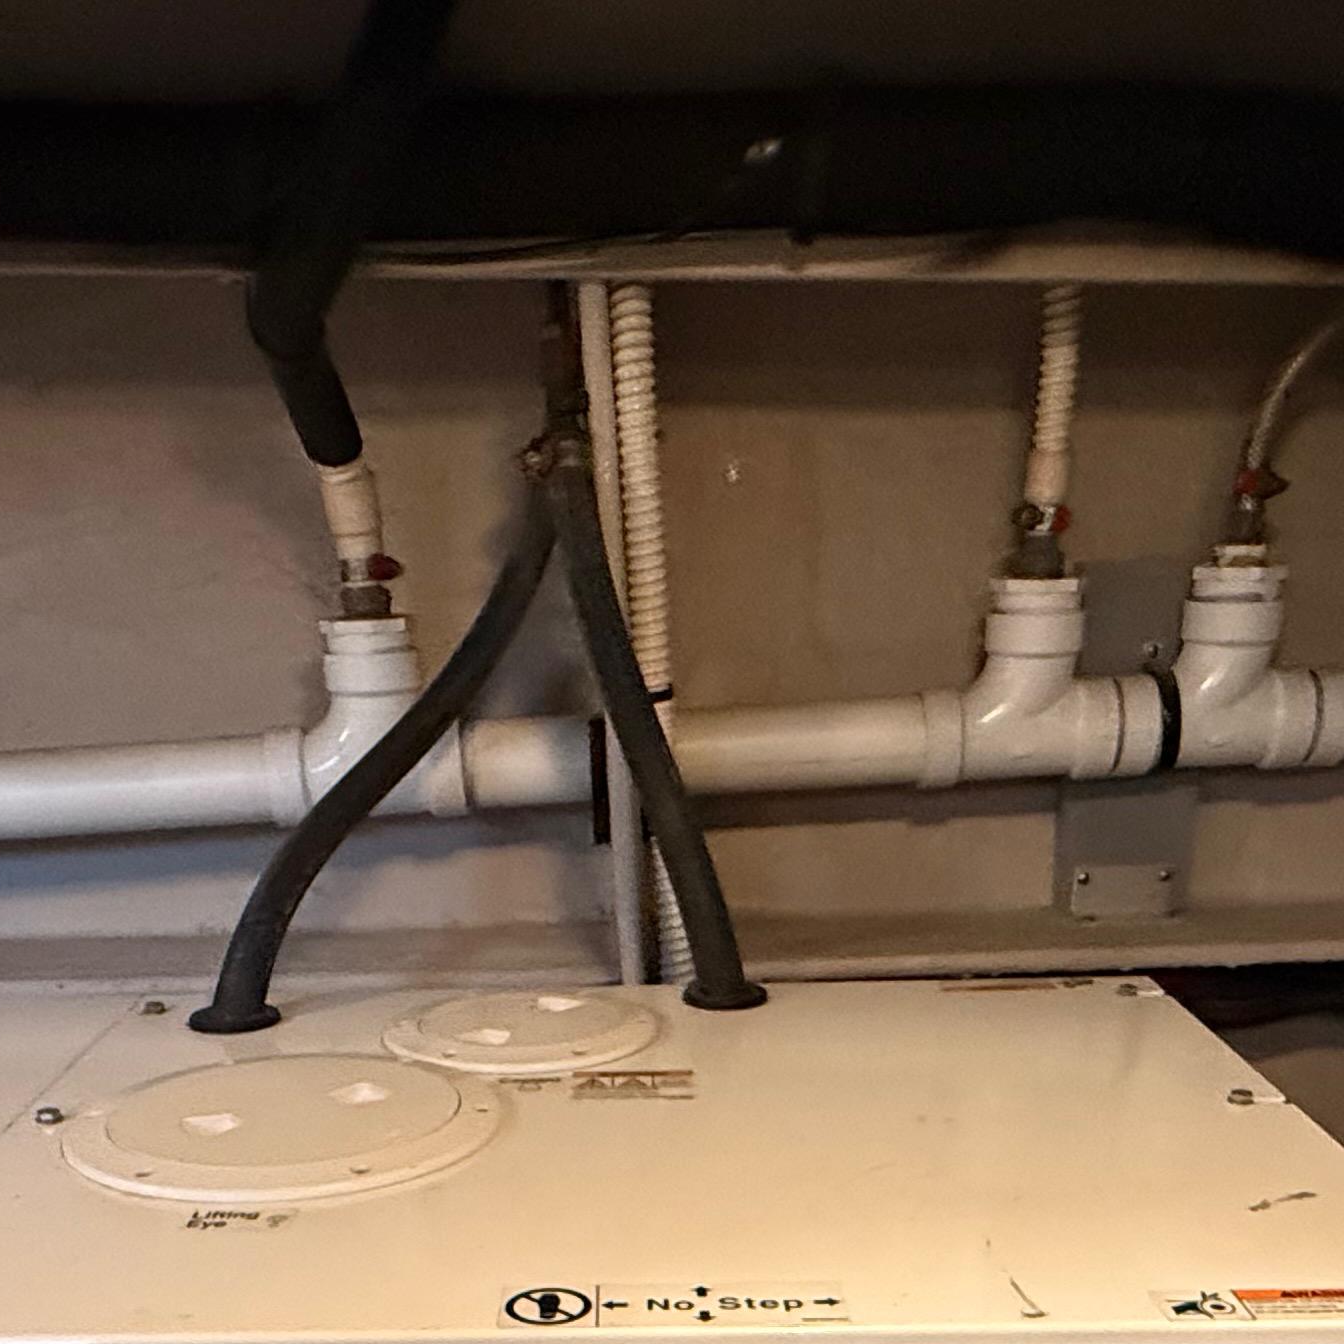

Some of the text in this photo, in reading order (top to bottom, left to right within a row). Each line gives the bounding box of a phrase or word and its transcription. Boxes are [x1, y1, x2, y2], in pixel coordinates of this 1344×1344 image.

[191, 1209, 261, 1221] Lifting
[185, 1219, 228, 1230] Eye
[647, 1296, 804, 1312] No Step
